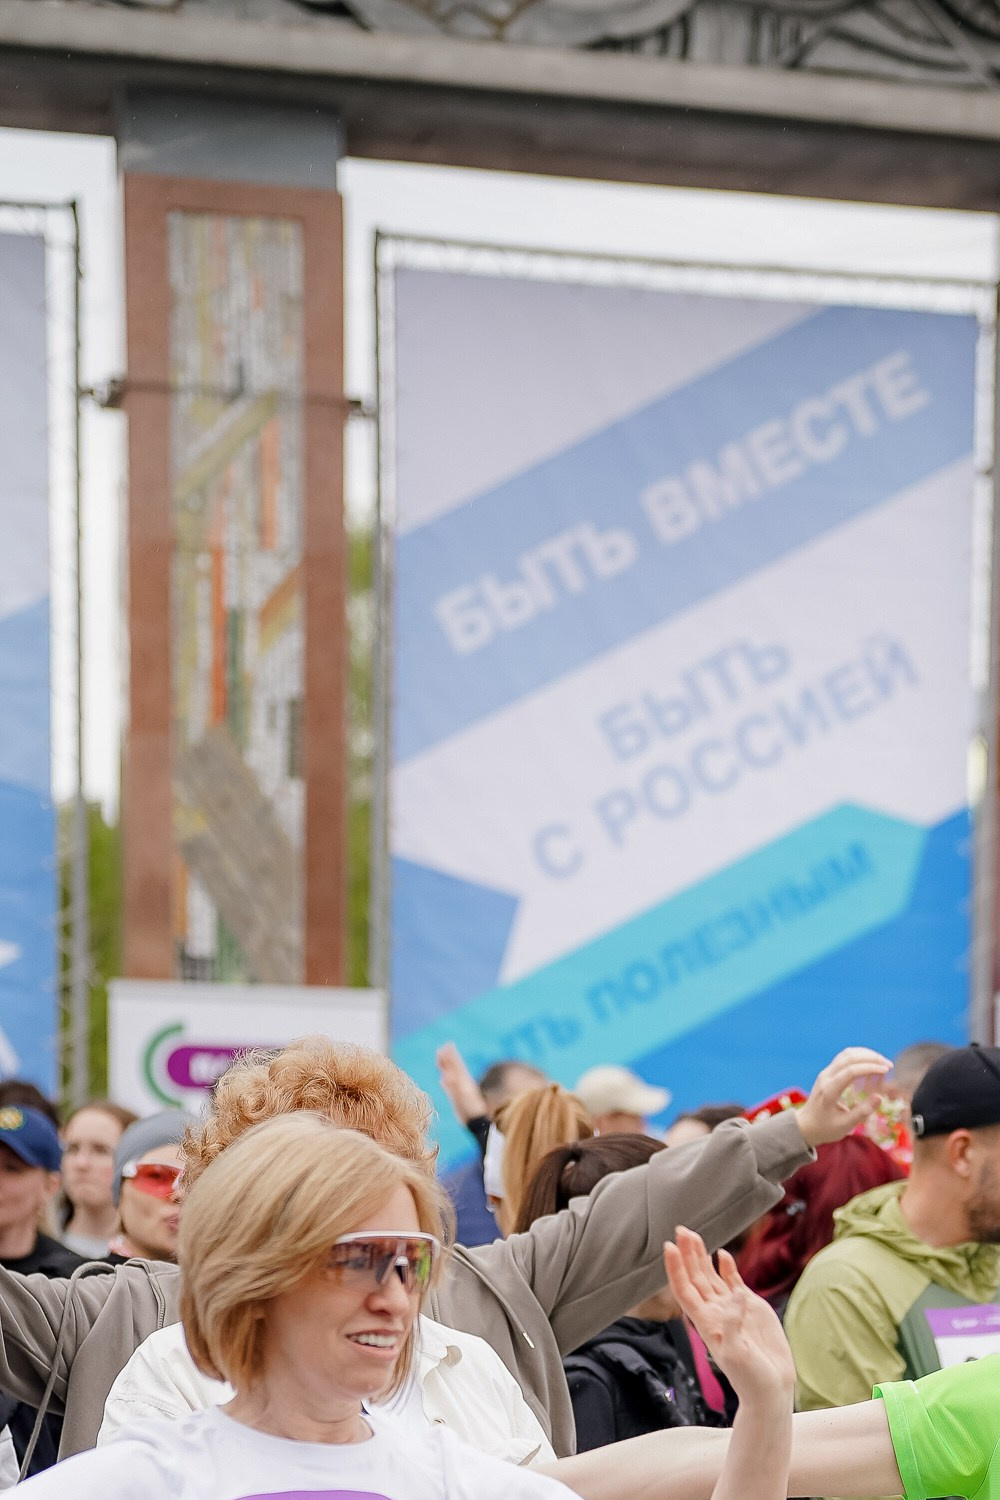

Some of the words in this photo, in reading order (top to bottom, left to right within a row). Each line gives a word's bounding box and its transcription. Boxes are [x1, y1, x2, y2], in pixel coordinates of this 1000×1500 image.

[434, 526, 639, 655] БЫТЬ
[640, 351, 931, 545] ВМЕСТЕ
[533, 824, 584, 879] С
[595, 632, 918, 847] РОССИЕЙ
[597, 640, 790, 761] БЫТЬ
